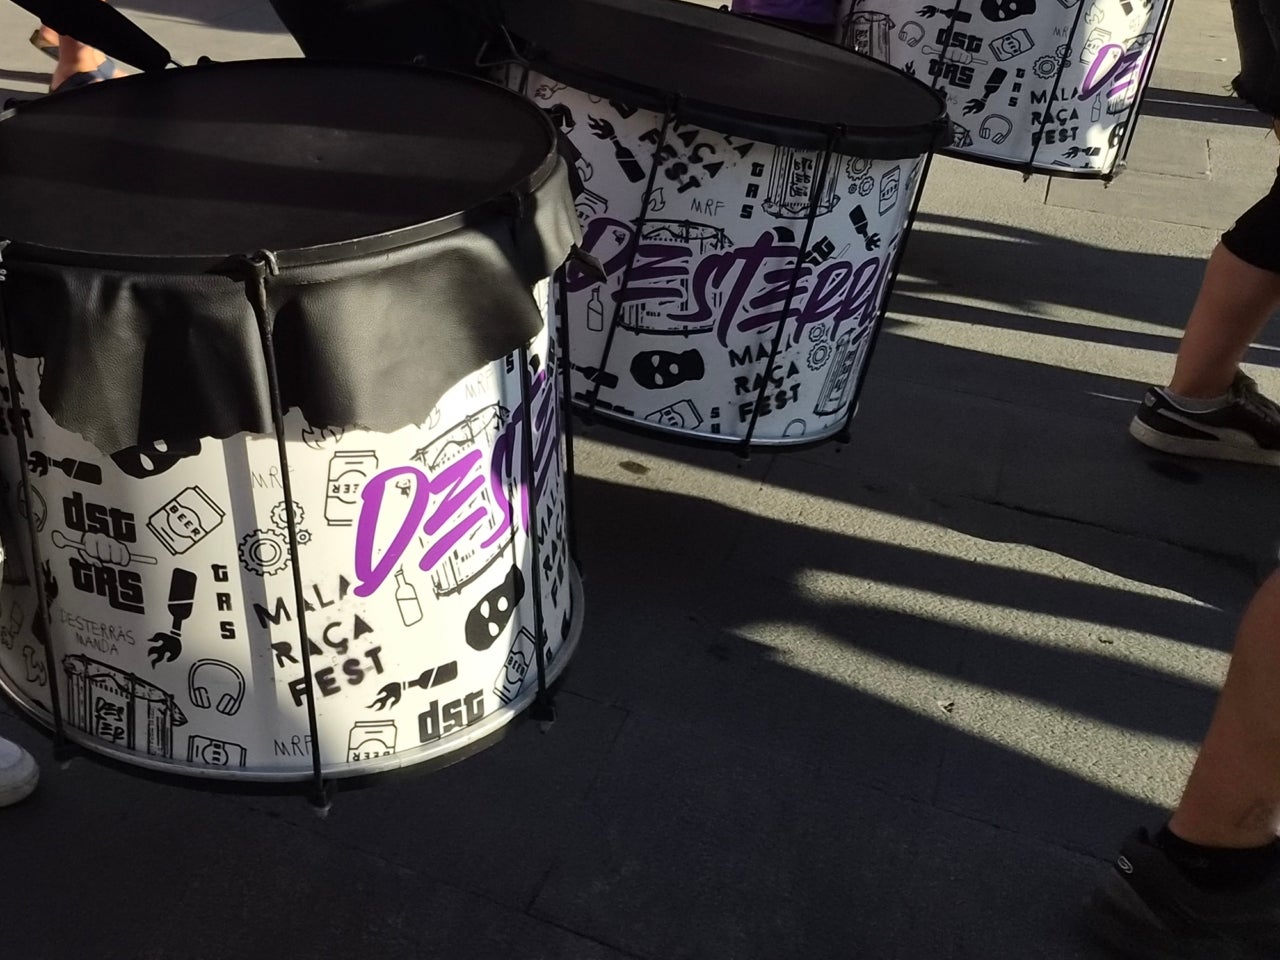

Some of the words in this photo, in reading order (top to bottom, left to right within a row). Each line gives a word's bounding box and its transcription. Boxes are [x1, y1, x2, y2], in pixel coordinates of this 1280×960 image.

[1031, 107, 1079, 126] RAÇA
[1031, 126, 1080, 147] FEST
[690, 197, 726, 217] MRF
[733, 361, 800, 396] RAÇA
[738, 383, 801, 423] FEST
[169, 504, 201, 538] BEER
[75, 631, 120, 656] MANDA
[270, 613, 375, 669] RAÇA
[287, 645, 385, 708] FEST
